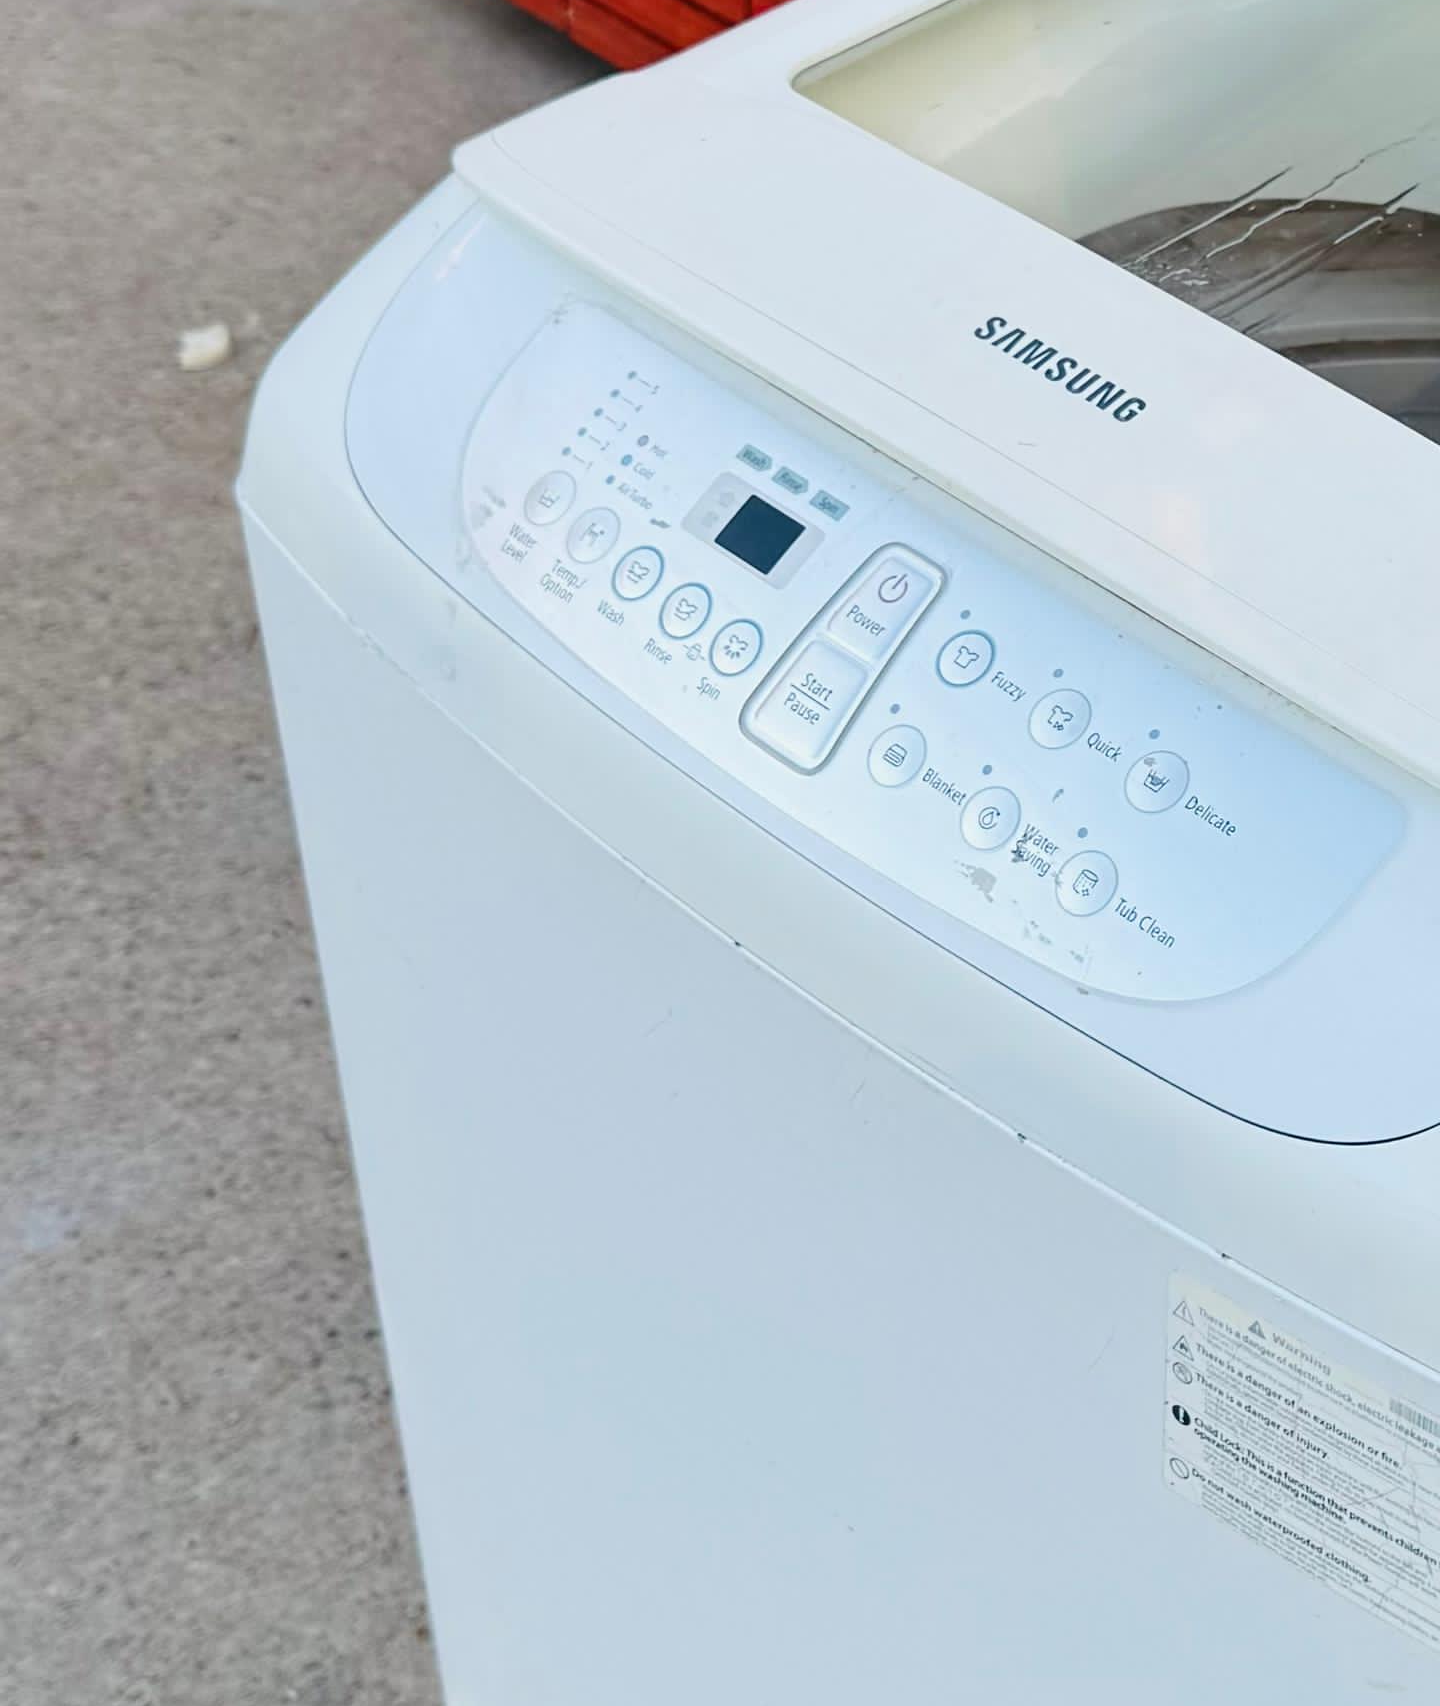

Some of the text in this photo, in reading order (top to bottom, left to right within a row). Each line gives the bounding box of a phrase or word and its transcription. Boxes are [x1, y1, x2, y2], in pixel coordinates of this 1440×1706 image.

[974, 316, 1147, 423] SAMSUNG
[501, 539, 528, 564] Level
[509, 522, 538, 549] Water
[539, 572, 574, 604] Option
[596, 599, 626, 627] Wash
[846, 604, 887, 637] Power
[643, 637, 673, 665] Rinse
[696, 676, 722, 701] Spin
[801, 673, 833, 702] Start
[990, 671, 1028, 703] Fuzzy
[783, 693, 821, 725] Pause
[1086, 732, 1122, 762] Quick
[922, 768, 967, 806] Blanket
[1183, 795, 1237, 837] Delicate
[1023, 823, 1060, 855] Water
[1114, 898, 1176, 948] Tub Clean
[1272, 1332, 1332, 1376] Warning
[1196, 1372, 1224, 1397] There
[1226, 1393, 1234, 1404] is
[1236, 1400, 1242, 1408] a
[1244, 1405, 1280, 1431] danger
[1283, 1426, 1294, 1438] of
[1197, 1343, 1224, 1367] There
[1227, 1363, 1235, 1373] is
[1237, 1371, 1243, 1379] a
[1245, 1374, 1282, 1401] danger
[1284, 1396, 1295, 1408] of
[1297, 1406, 1311, 1419] an
[1313, 1414, 1365, 1450] explosion
[1367, 1445, 1379, 1457] or
[1242, 1334, 1275, 1358] danger
[1395, 1420, 1434, 1449] leakage
[1194, 1428, 1239, 1462] operating
[1241, 1455, 1257, 1471] the
[1259, 1468, 1299, 1499] washing
[1194, 1417, 1218, 1438] Child
[1247, 1448, 1265, 1467] This
[1267, 1463, 1275, 1472] is
[1284, 1471, 1326, 1502] function
[1327, 1497, 1348, 1515] that
[1349, 1512, 1394, 1542] prevents
[1395, 1538, 1437, 1566] children
[1192, 1468, 1206, 1482] Do
[1207, 1479, 1224, 1494] not
[1226, 1492, 1252, 1511] wash
[1253, 1507, 1323, 1555] waterproofed
